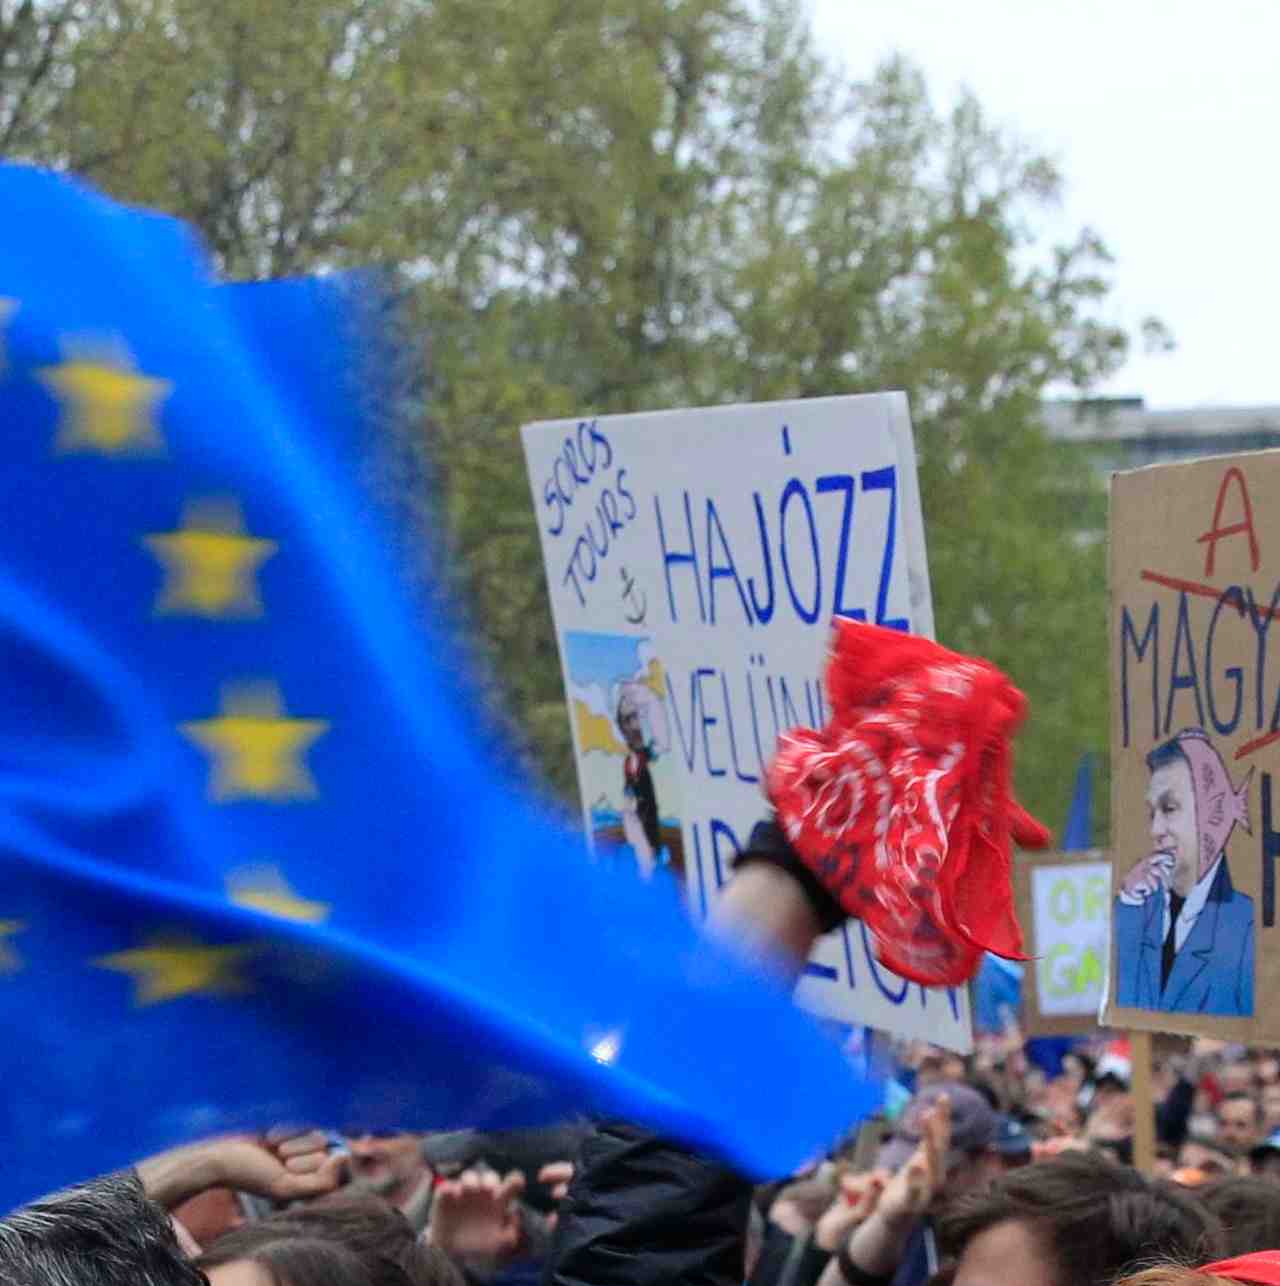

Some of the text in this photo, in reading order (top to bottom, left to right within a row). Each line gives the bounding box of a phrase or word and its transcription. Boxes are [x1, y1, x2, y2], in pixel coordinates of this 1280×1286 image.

[563, 468, 636, 608] TOURS
[654, 426, 909, 631] HAJÓZZ
[1197, 466, 1260, 577] A
